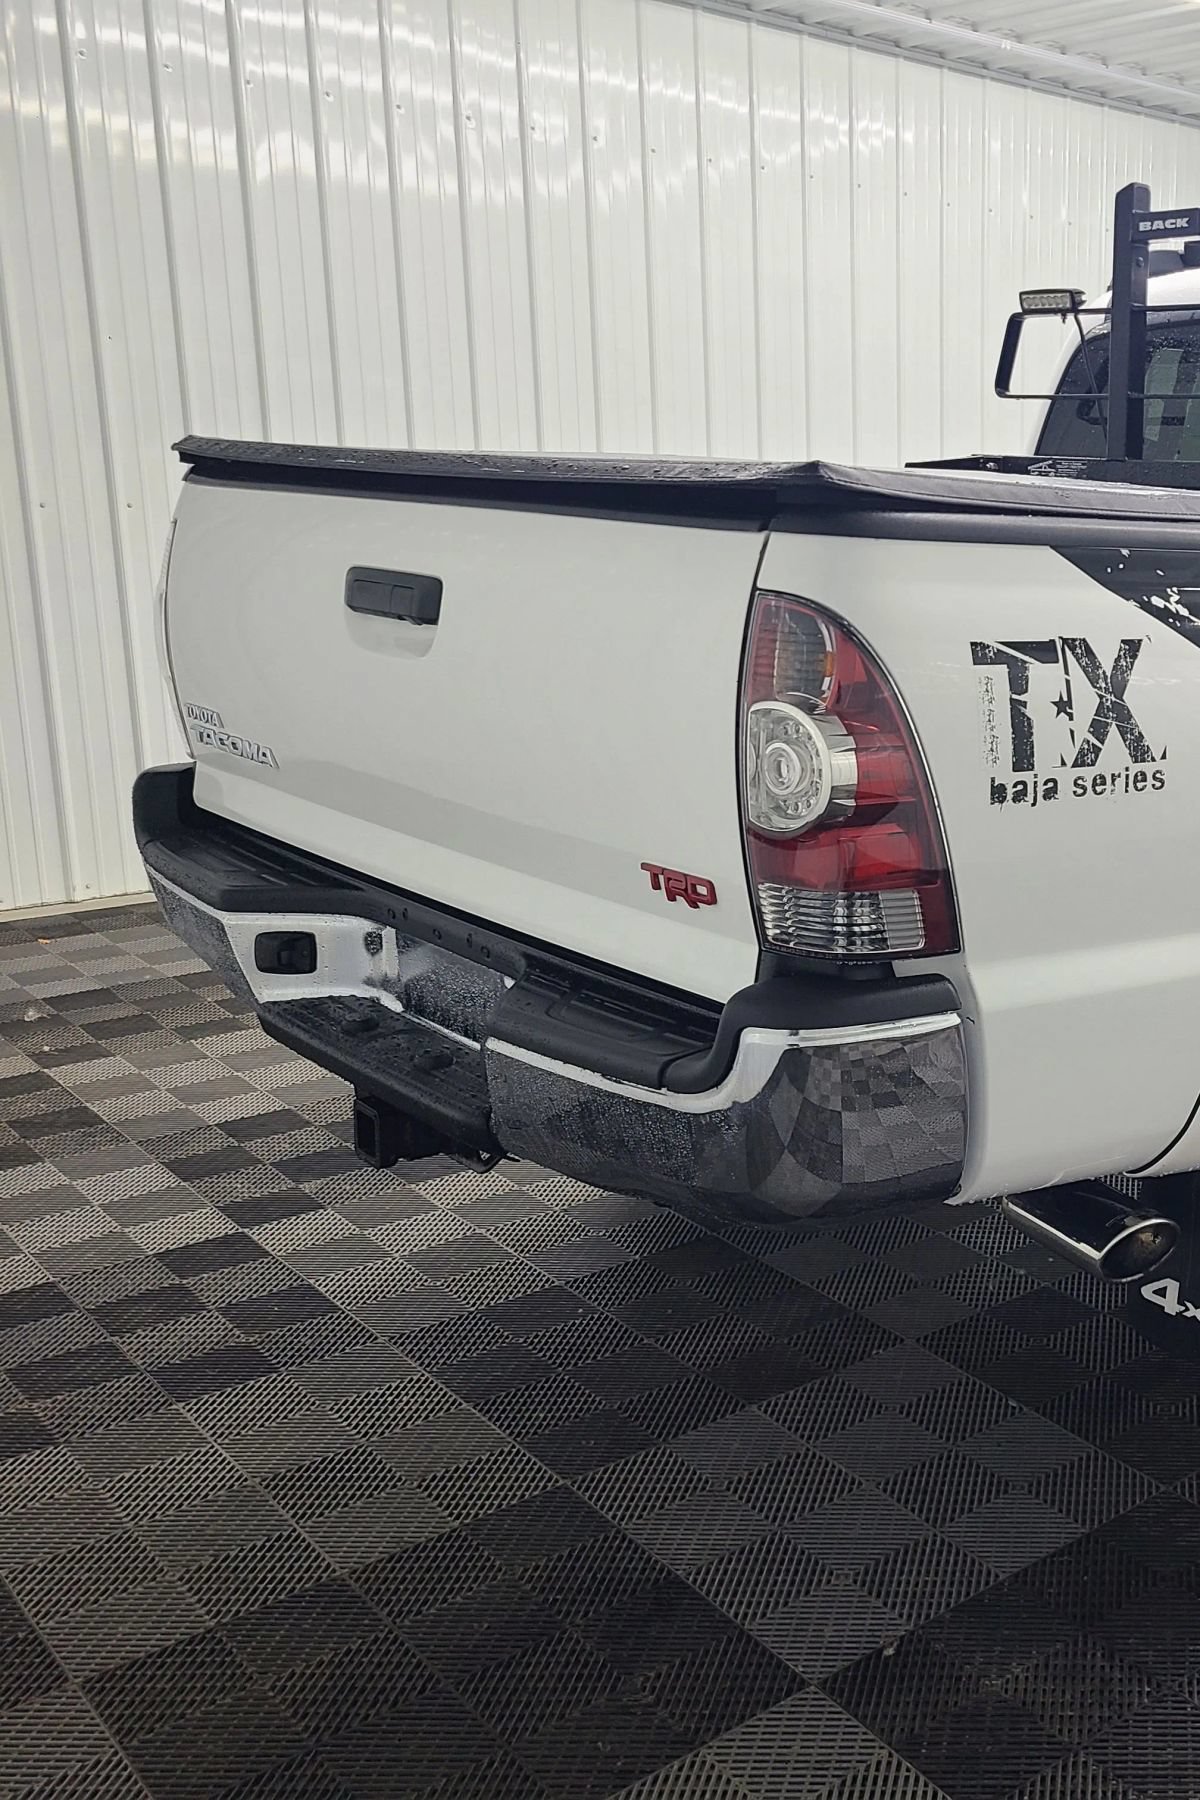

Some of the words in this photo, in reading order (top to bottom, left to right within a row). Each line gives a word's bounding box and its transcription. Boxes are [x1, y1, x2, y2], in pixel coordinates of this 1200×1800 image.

[1138, 218, 1189, 232] BACK
[184, 702, 224, 729] TOYOTA
[190, 724, 280, 769] TACOMA
[990, 773, 1059, 808] baja
[1072, 766, 1166, 798] series
[640, 862, 718, 909] TRD
